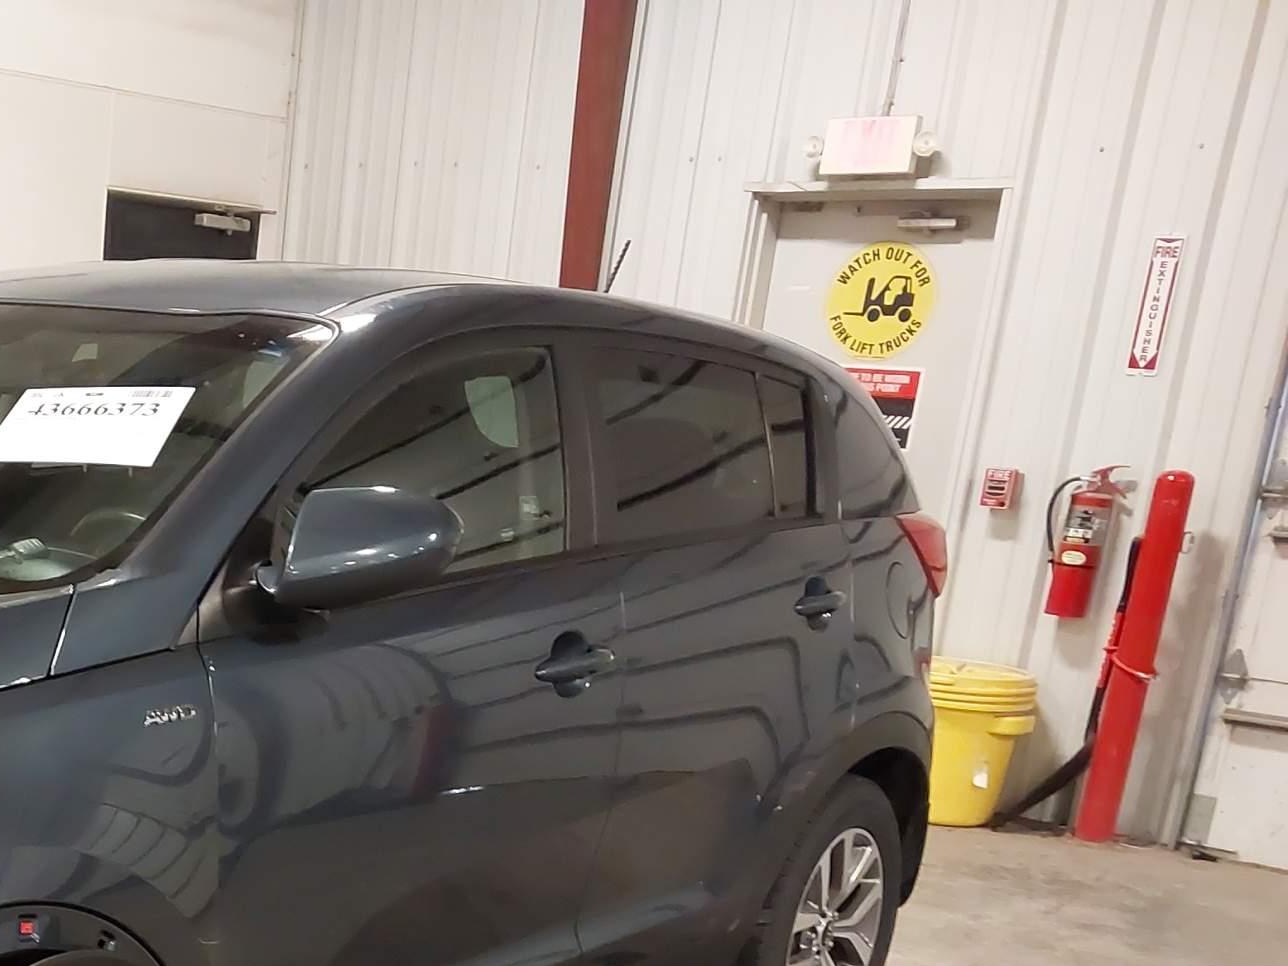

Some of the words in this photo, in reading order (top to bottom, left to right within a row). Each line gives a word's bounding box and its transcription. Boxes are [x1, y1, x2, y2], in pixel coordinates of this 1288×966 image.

[837, 247, 881, 285] WATCH
[885, 247, 913, 264] OUT
[910, 260, 931, 287] FOR
[1155, 246, 1180, 258] FIRE
[1140, 260, 1168, 362] EXTINGUISHER
[830, 315, 852, 345] FORK
[849, 339, 875, 355] LIFT
[879, 320, 922, 354] TRUCKS
[27, 402, 161, 417] 43666373
